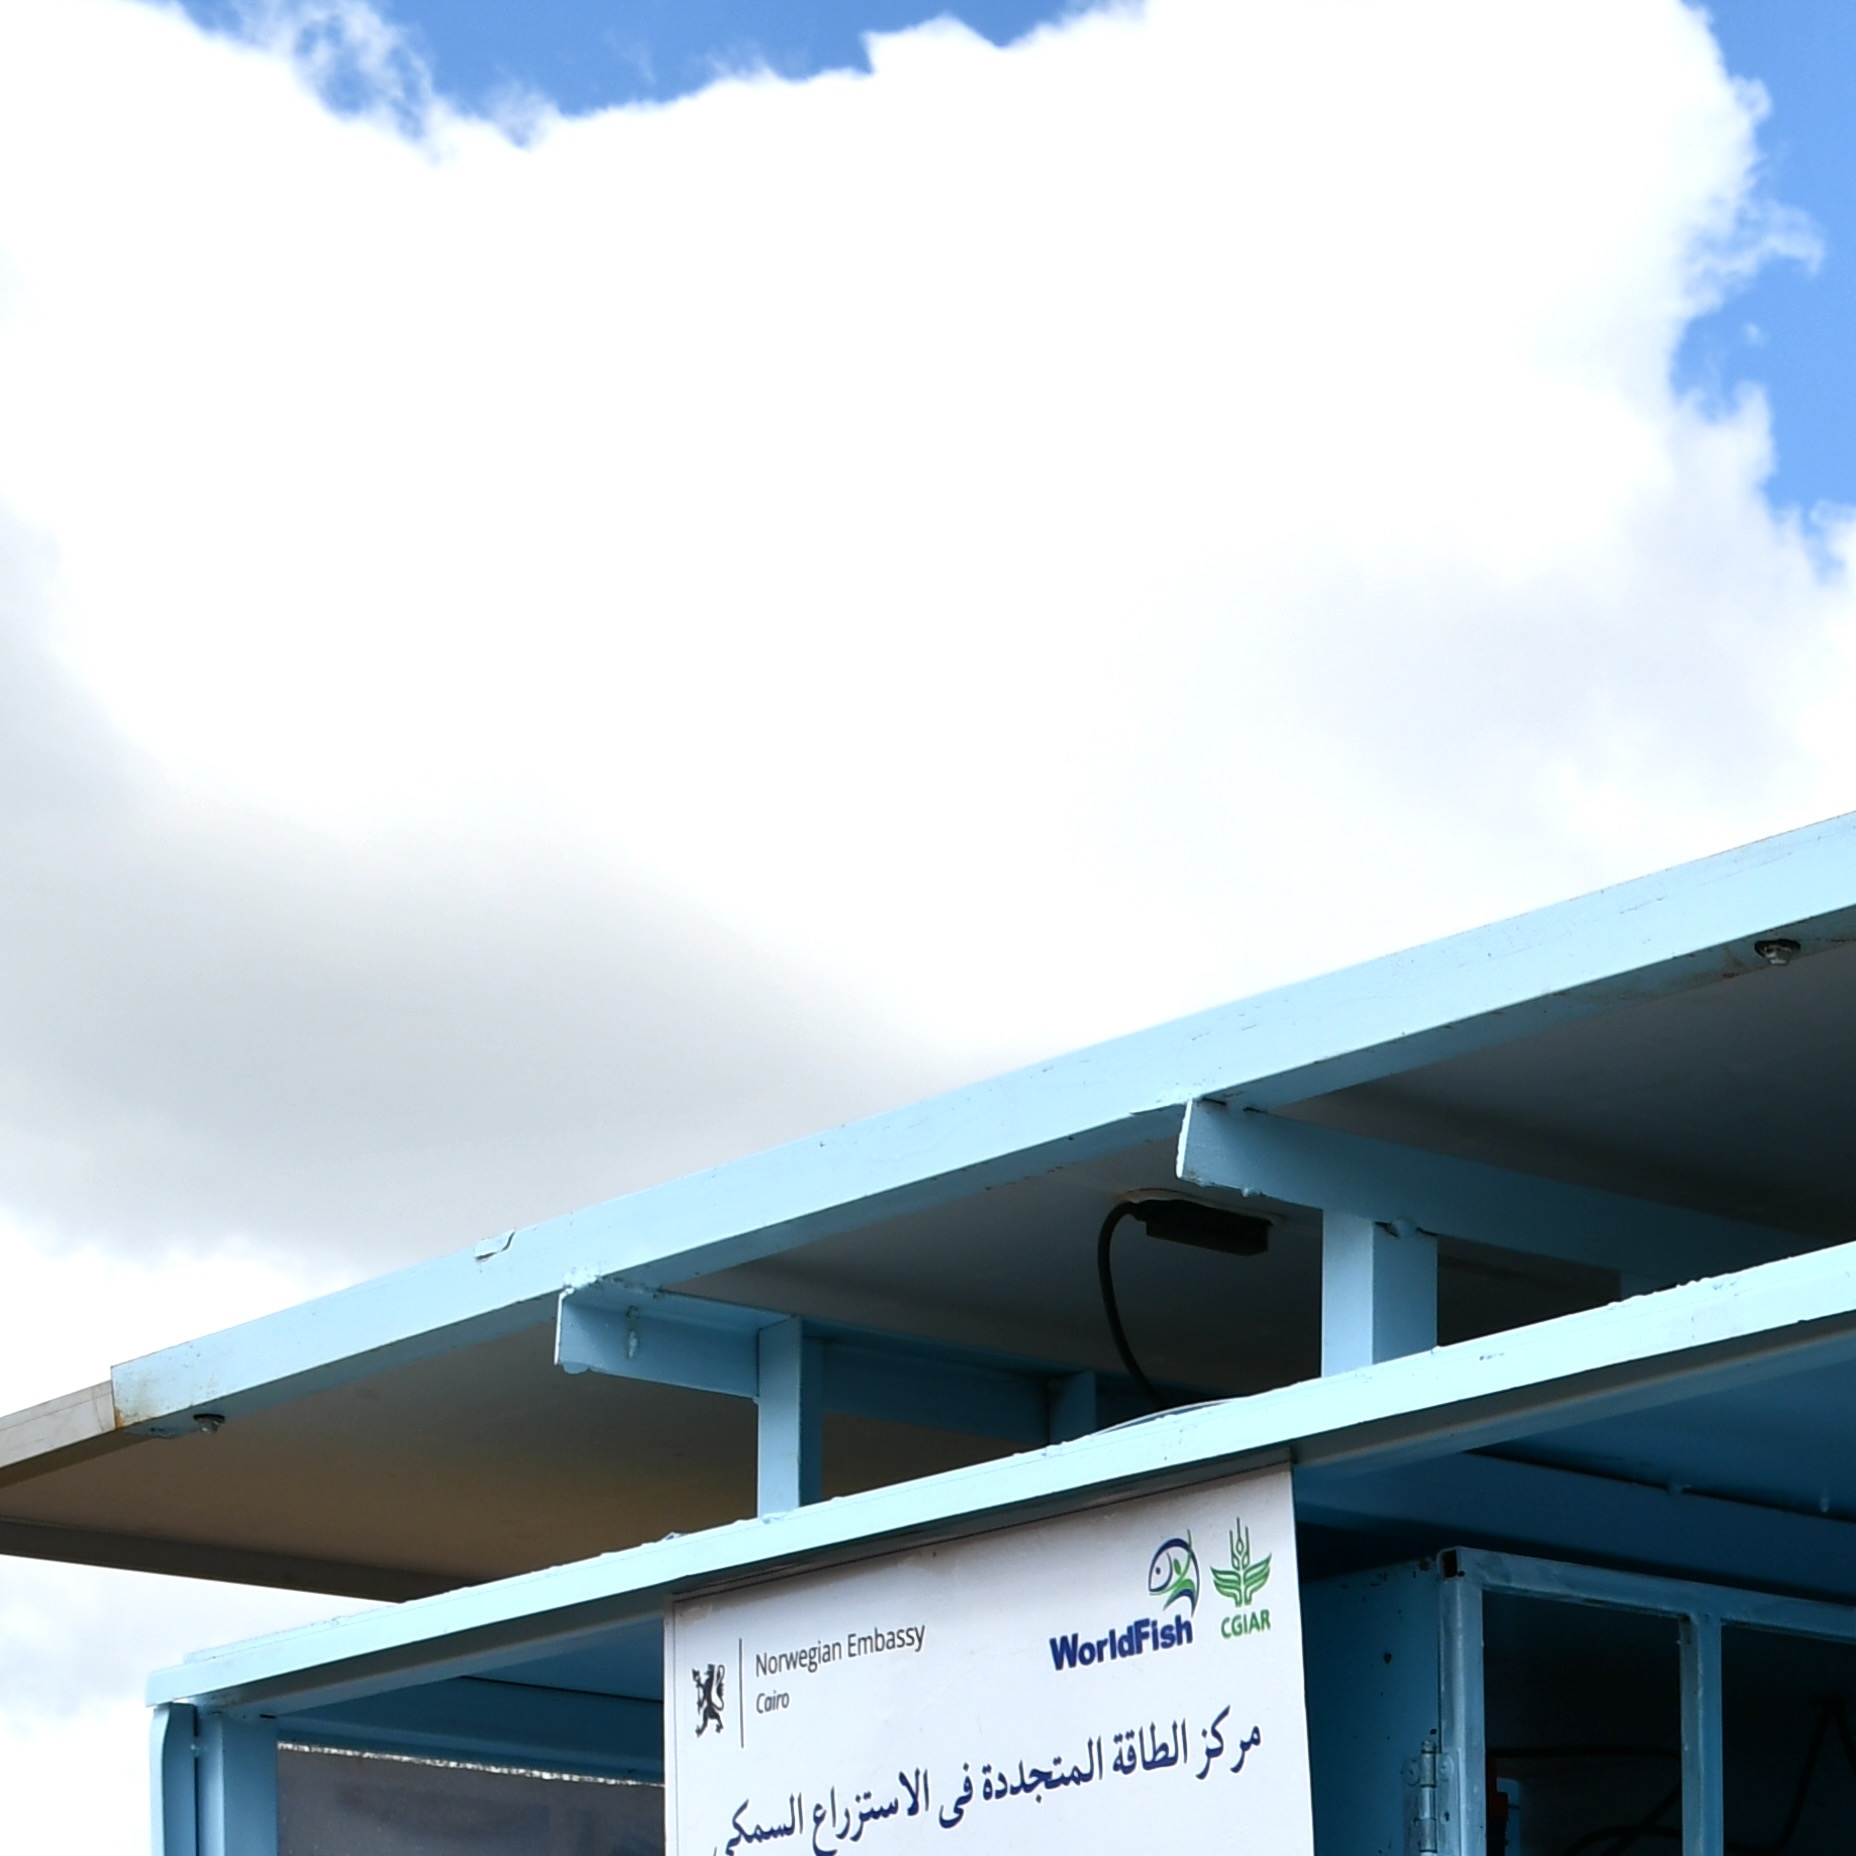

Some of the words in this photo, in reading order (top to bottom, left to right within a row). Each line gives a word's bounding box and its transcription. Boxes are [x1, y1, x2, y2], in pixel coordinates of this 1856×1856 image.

[755, 1640, 843, 1678] Norwegian
[847, 1624, 925, 1658] Embassy
[1049, 1614, 1194, 1671] WorldFish
[1221, 1609, 1271, 1639] CGIAR
[755, 1689, 790, 1714] Cairo
[982, 1735, 1103, 1805] المتجددة
[1111, 1717, 1189, 1776] الطاقة
[1196, 1705, 1262, 1779] مركز
